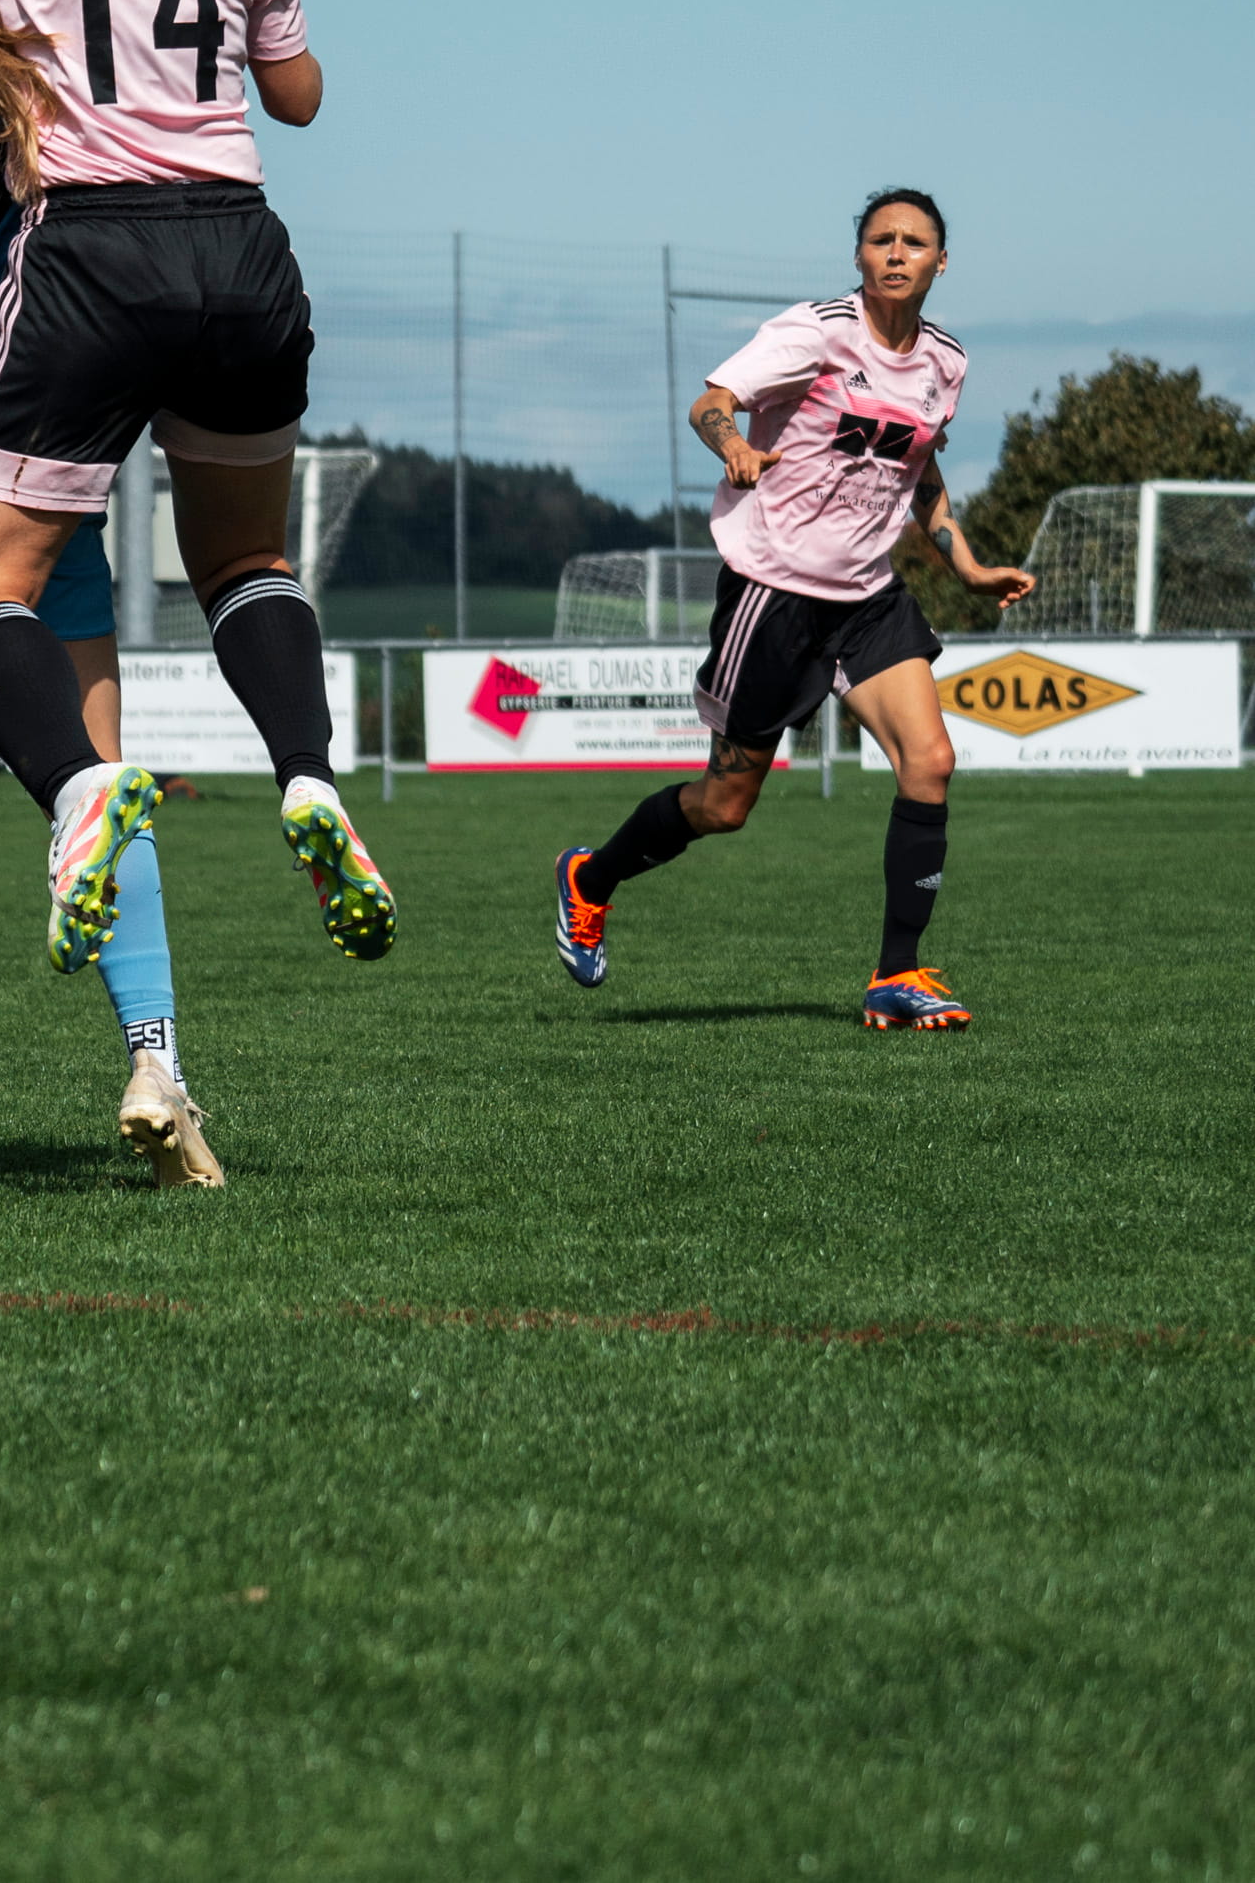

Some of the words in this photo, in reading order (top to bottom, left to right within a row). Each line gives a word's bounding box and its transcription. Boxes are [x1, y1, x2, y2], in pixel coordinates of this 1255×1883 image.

[589, 659, 654, 689] DUMAS
[500, 695, 559, 712] GYPSERIE
[572, 695, 631, 711] PEINTURE
[953, 677, 1087, 712] COLAS
[1017, 746, 1049, 762] La
[1058, 746, 1127, 761] route
[1136, 747, 1233, 762] avance
[125, 1021, 163, 1052] FS
